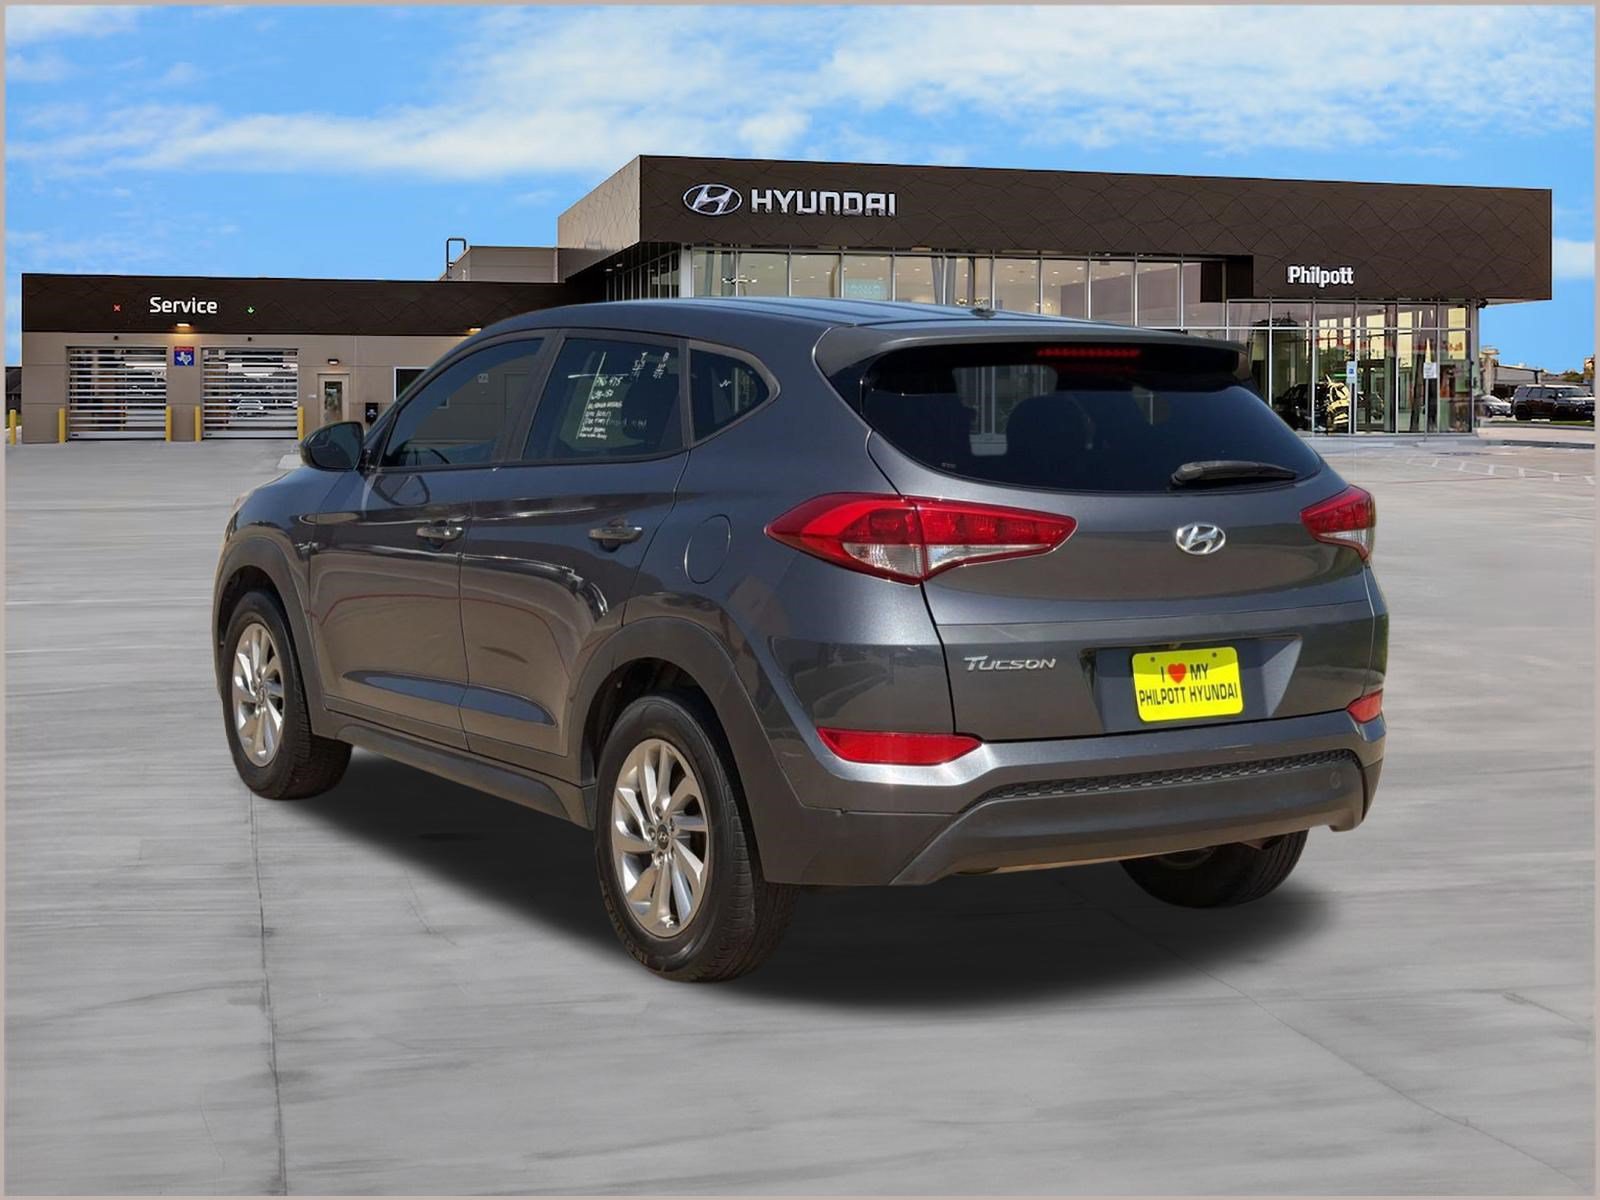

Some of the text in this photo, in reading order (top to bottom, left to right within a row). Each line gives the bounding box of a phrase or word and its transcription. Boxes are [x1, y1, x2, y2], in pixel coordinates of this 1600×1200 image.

[751, 189, 896, 216] HYUNDAI
[1287, 265, 1355, 288] Philpott
[149, 296, 218, 314] Service
[964, 655, 1057, 672] TUCSON
[1160, 663, 1209, 683] I MY
[1139, 682, 1239, 707] PHILPOTT HYUNDAI
